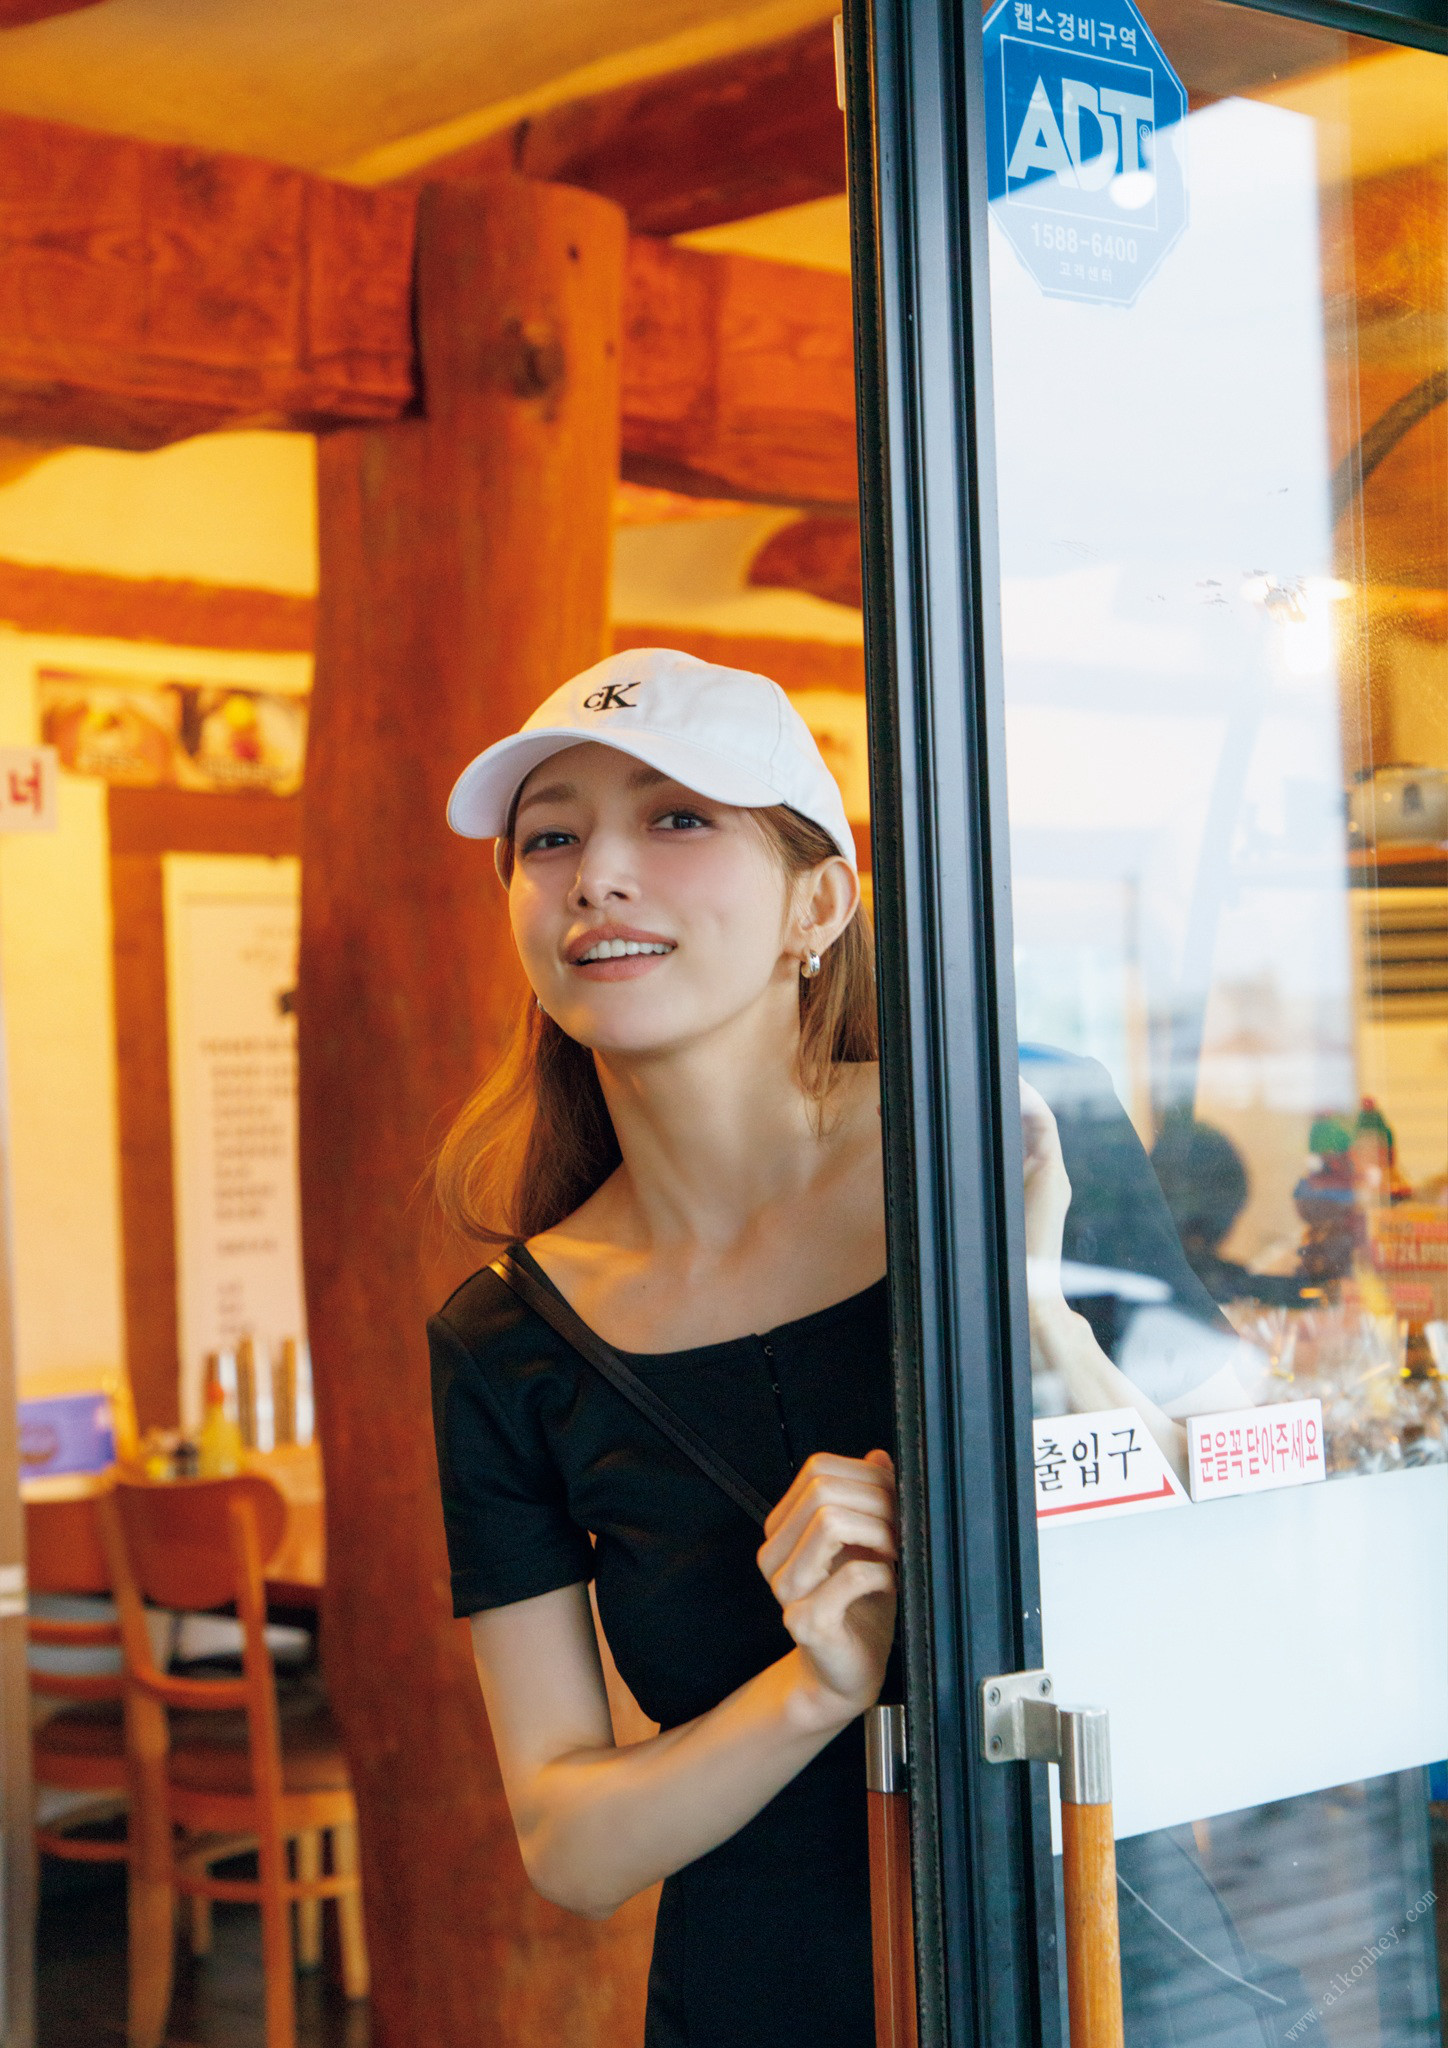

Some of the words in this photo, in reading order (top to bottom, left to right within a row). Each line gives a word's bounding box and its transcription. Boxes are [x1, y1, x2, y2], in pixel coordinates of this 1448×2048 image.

[1014, 4, 1136, 56] 캡스경비구역
[1007, 75, 1154, 192] ADT
[1031, 222, 1138, 264] 1588-6400
[1035, 1429, 1142, 1491] 출입구
